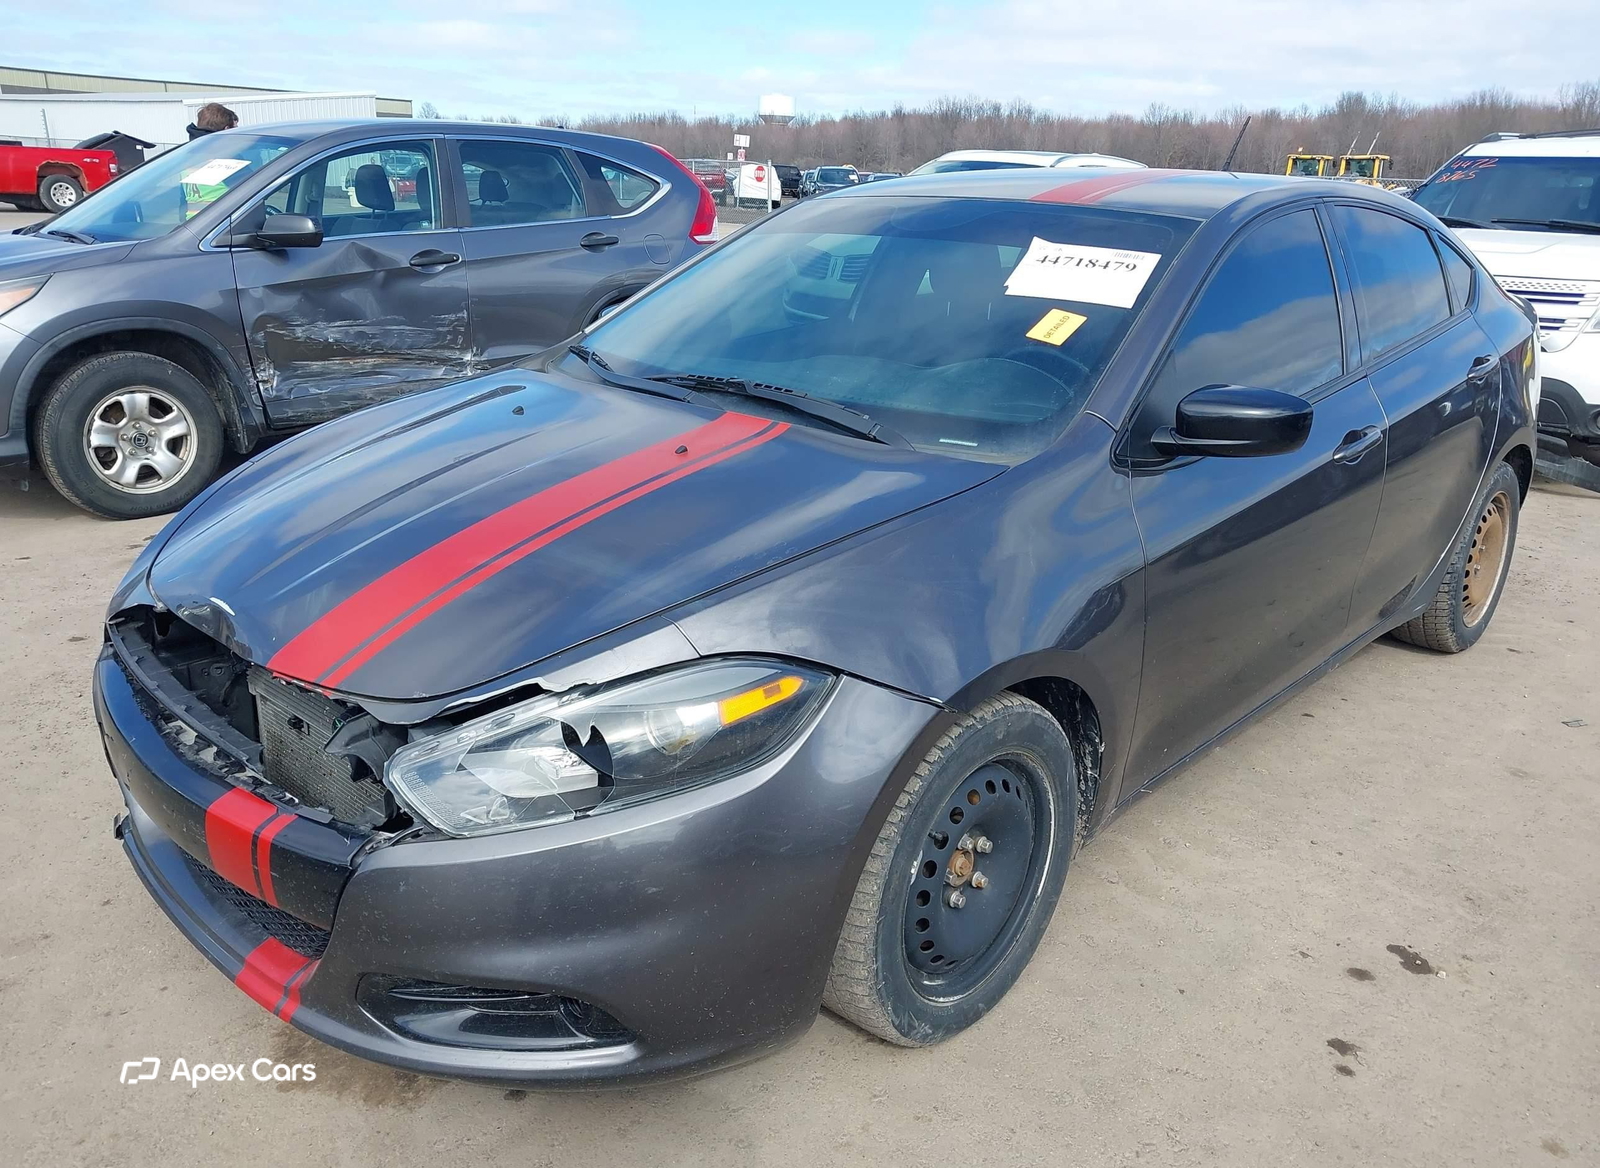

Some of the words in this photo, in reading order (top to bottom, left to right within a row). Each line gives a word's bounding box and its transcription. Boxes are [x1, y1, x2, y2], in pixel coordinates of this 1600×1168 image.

[1450, 158, 1499, 170] 4472
[1035, 254, 1138, 273] 44718479
[1043, 314, 1071, 339] DETAILED
